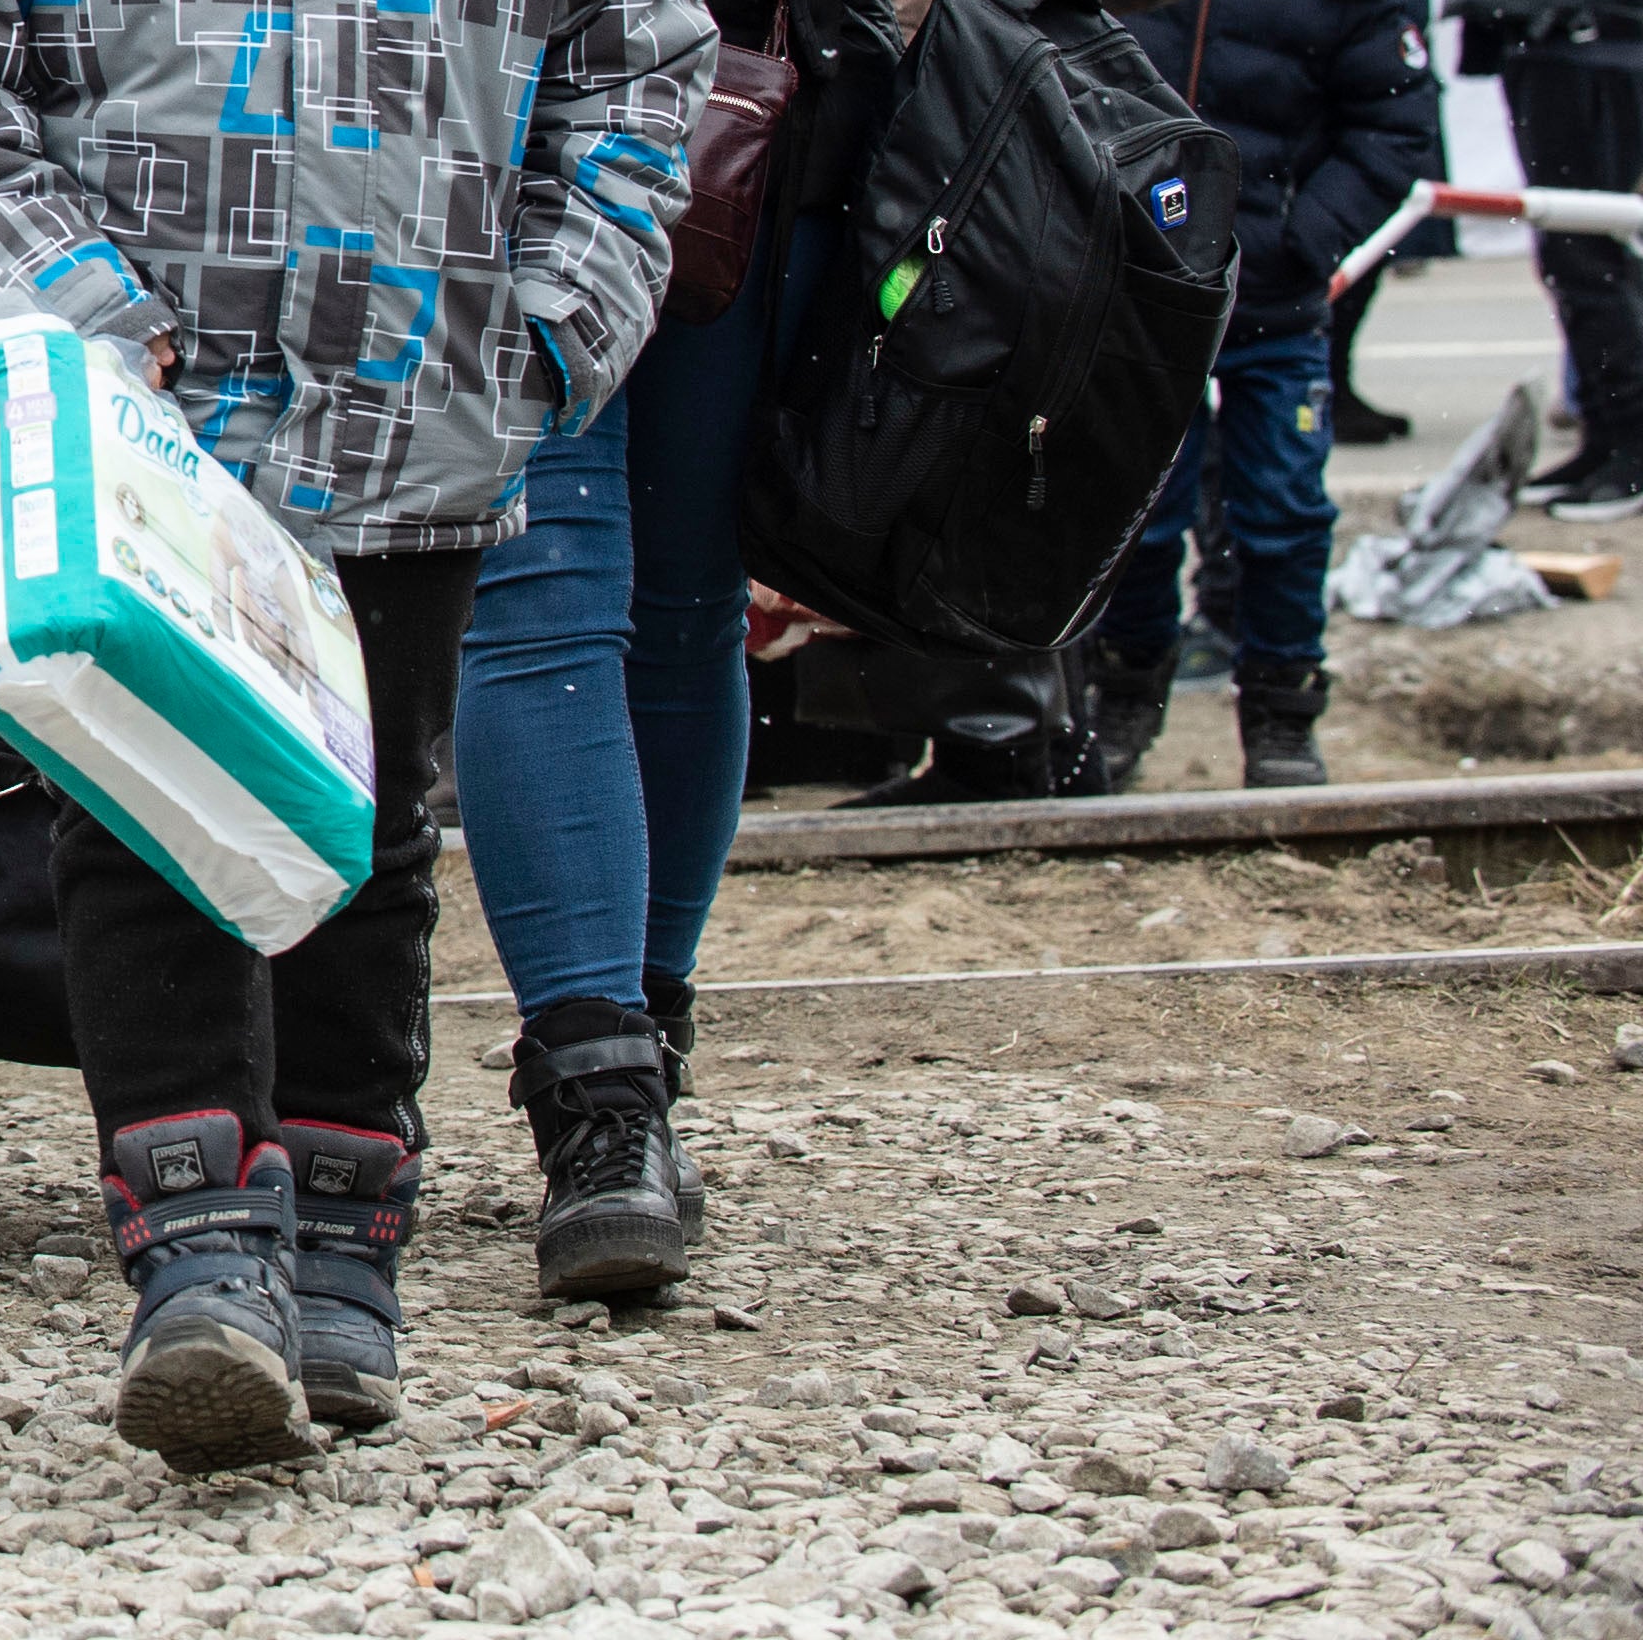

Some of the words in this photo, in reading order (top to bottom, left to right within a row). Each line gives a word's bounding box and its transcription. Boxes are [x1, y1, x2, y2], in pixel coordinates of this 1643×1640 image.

[111, 393, 200, 482] Dada
[163, 1213, 206, 1233] STREET
[208, 1208, 251, 1223] RACING
[313, 1221, 356, 1235] RACING
